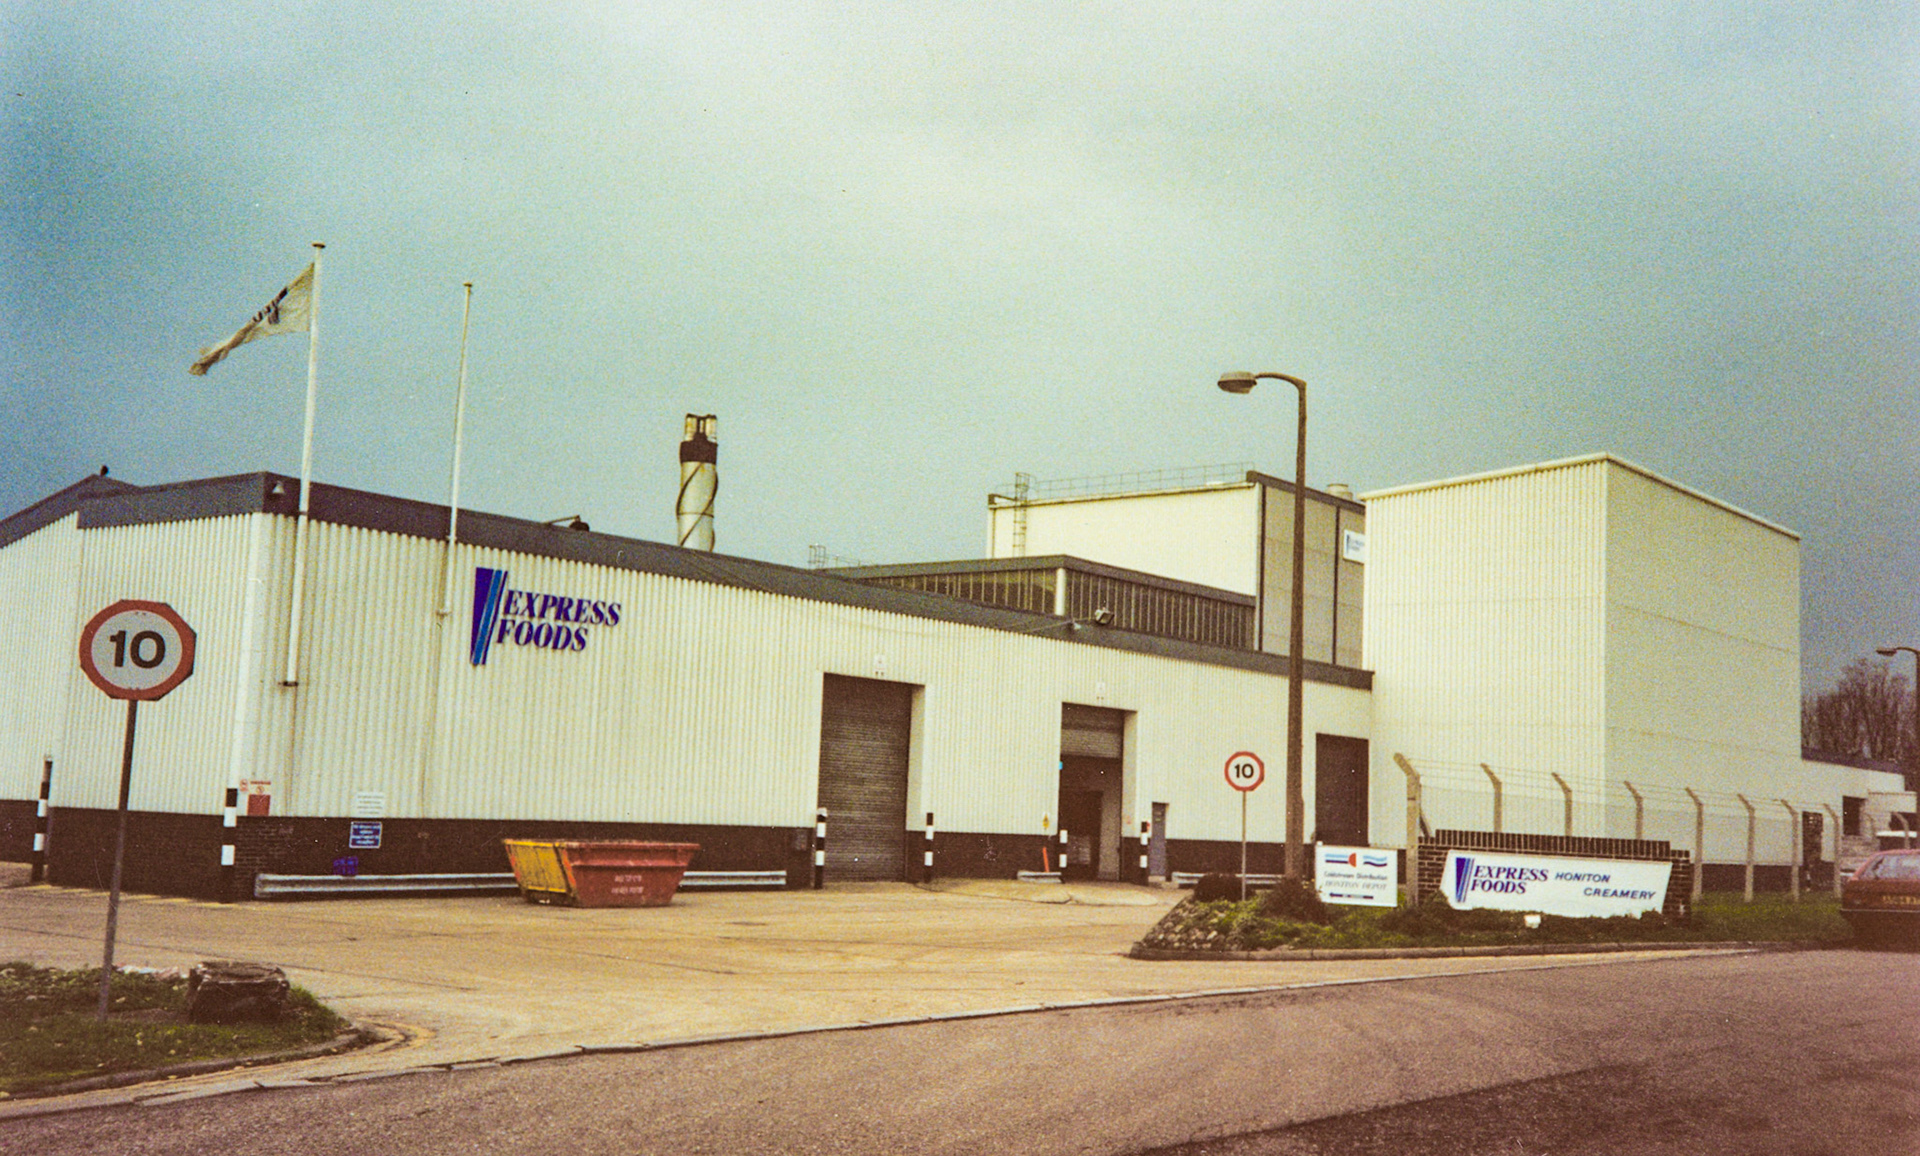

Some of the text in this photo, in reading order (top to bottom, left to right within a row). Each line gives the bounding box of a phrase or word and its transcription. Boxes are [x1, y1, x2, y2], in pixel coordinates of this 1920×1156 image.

[502, 589, 622, 627] EXPRESS
[496, 618, 588, 652] FOODS
[109, 630, 166, 669] 10
[1234, 763, 1255, 779] 10
[1473, 865, 1549, 882] EXPRESS
[1554, 872, 1612, 884] HONITON
[1470, 879, 1527, 895] FOODS
[1583, 887, 1657, 900] CREAMERY
